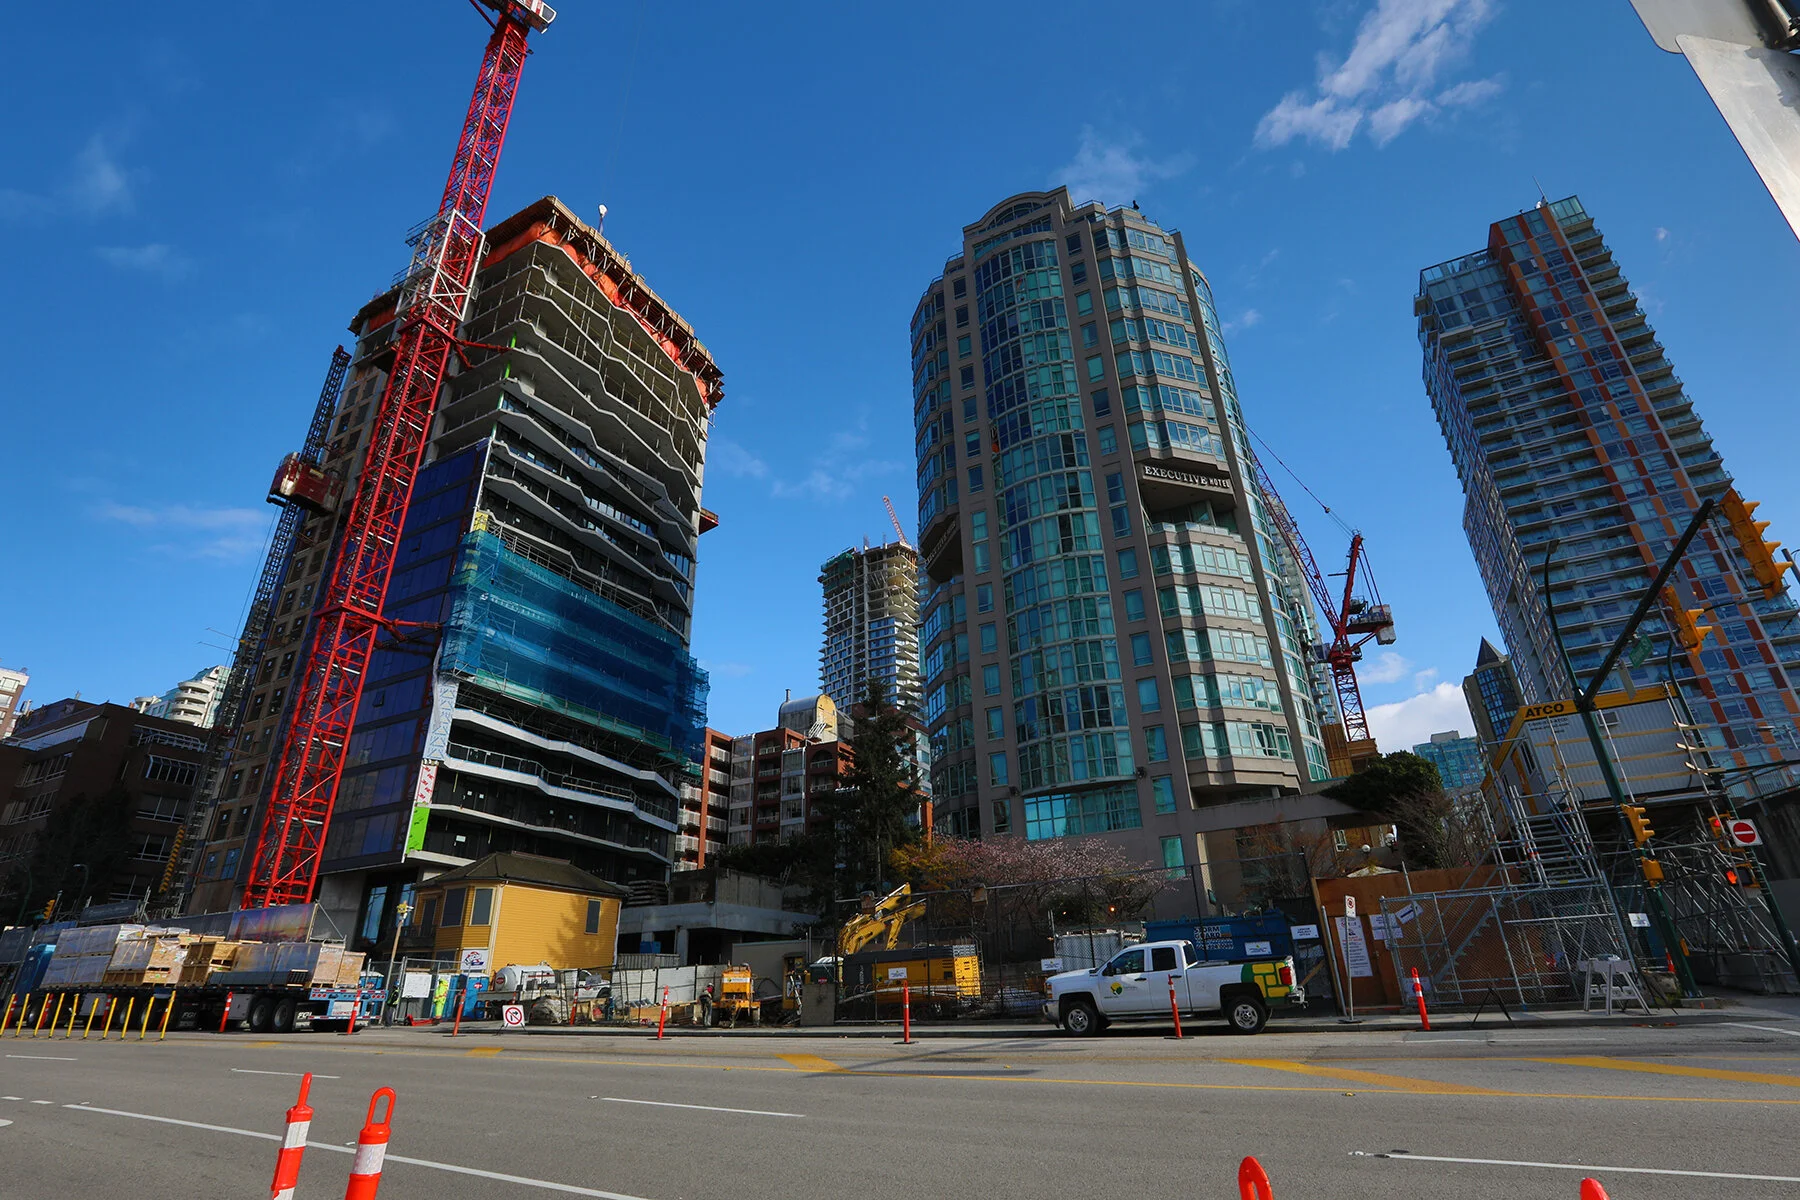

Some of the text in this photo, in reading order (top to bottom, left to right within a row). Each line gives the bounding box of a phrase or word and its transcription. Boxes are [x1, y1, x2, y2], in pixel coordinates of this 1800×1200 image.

[1144, 465, 1230, 488] EXECUTIVE HOTEL
[1525, 703, 1565, 718] ATCO
